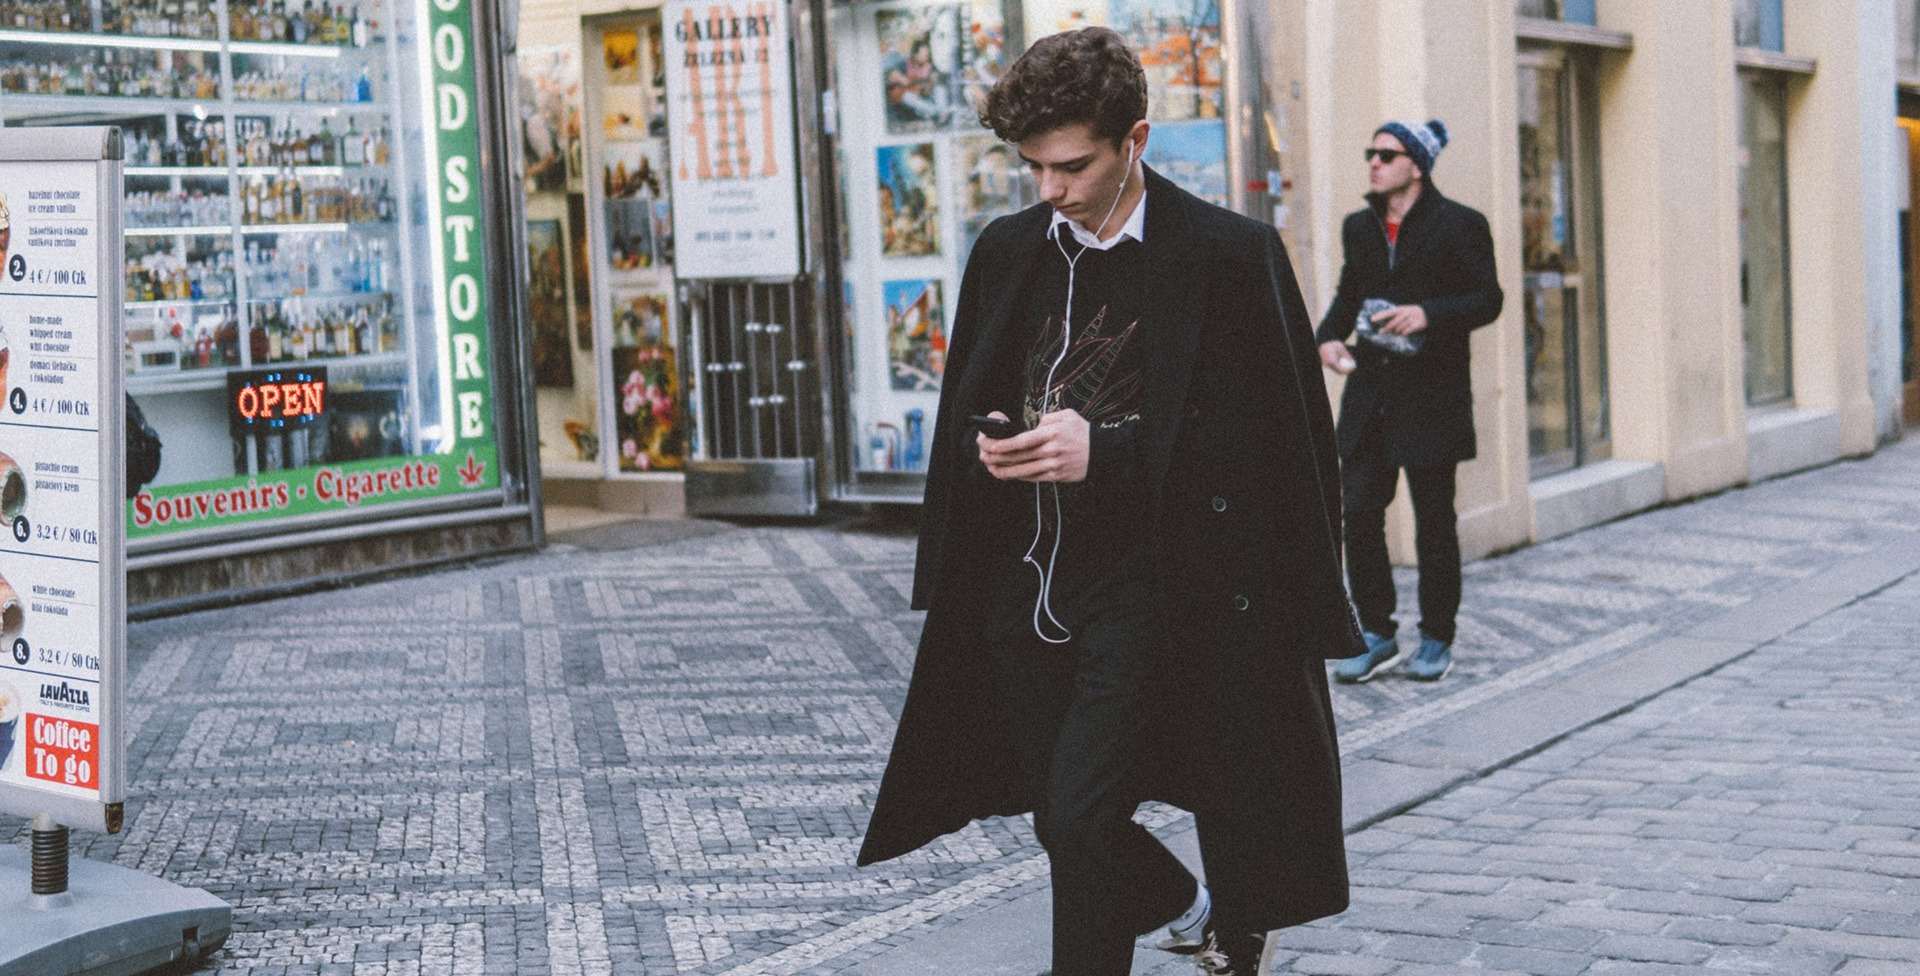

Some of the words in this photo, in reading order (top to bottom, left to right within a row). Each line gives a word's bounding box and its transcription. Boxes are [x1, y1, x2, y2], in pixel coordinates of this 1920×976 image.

[676, 15, 770, 41] GALLERY
[433, 0, 468, 130] OD
[53, 190, 80, 200] chocolate
[37, 205, 55, 213] cream
[29, 270, 35, 284] 4
[54, 270, 69, 285] 100
[72, 270, 86, 285] Czk
[444, 156, 484, 440] STORE
[30, 329, 53, 339] whipped
[55, 330, 72, 339] cream
[43, 342, 70, 353] chocolate
[33, 398, 38, 413] 4
[41, 398, 47, 413] €
[57, 400, 72, 415] 100
[75, 400, 90, 416] Czk
[238, 382, 325, 419] OPEN
[35, 461, 60, 473] pistachio
[61, 464, 80, 474] cream
[133, 480, 289, 527] Souvenirs
[315, 462, 441, 505] Cigarette
[53, 526, 59, 541] €
[69, 527, 81, 543] 80
[83, 528, 98, 545] Czk
[32, 585, 47, 594] white
[48, 587, 76, 599] chocolate
[55, 650, 61, 665] €
[71, 652, 83, 669] 80
[85, 654, 100, 671] Czk
[40, 681, 90, 706] LAVAZZA
[34, 717, 91, 753] Coffee
[34, 747, 58, 777] To
[65, 754, 91, 785] go
